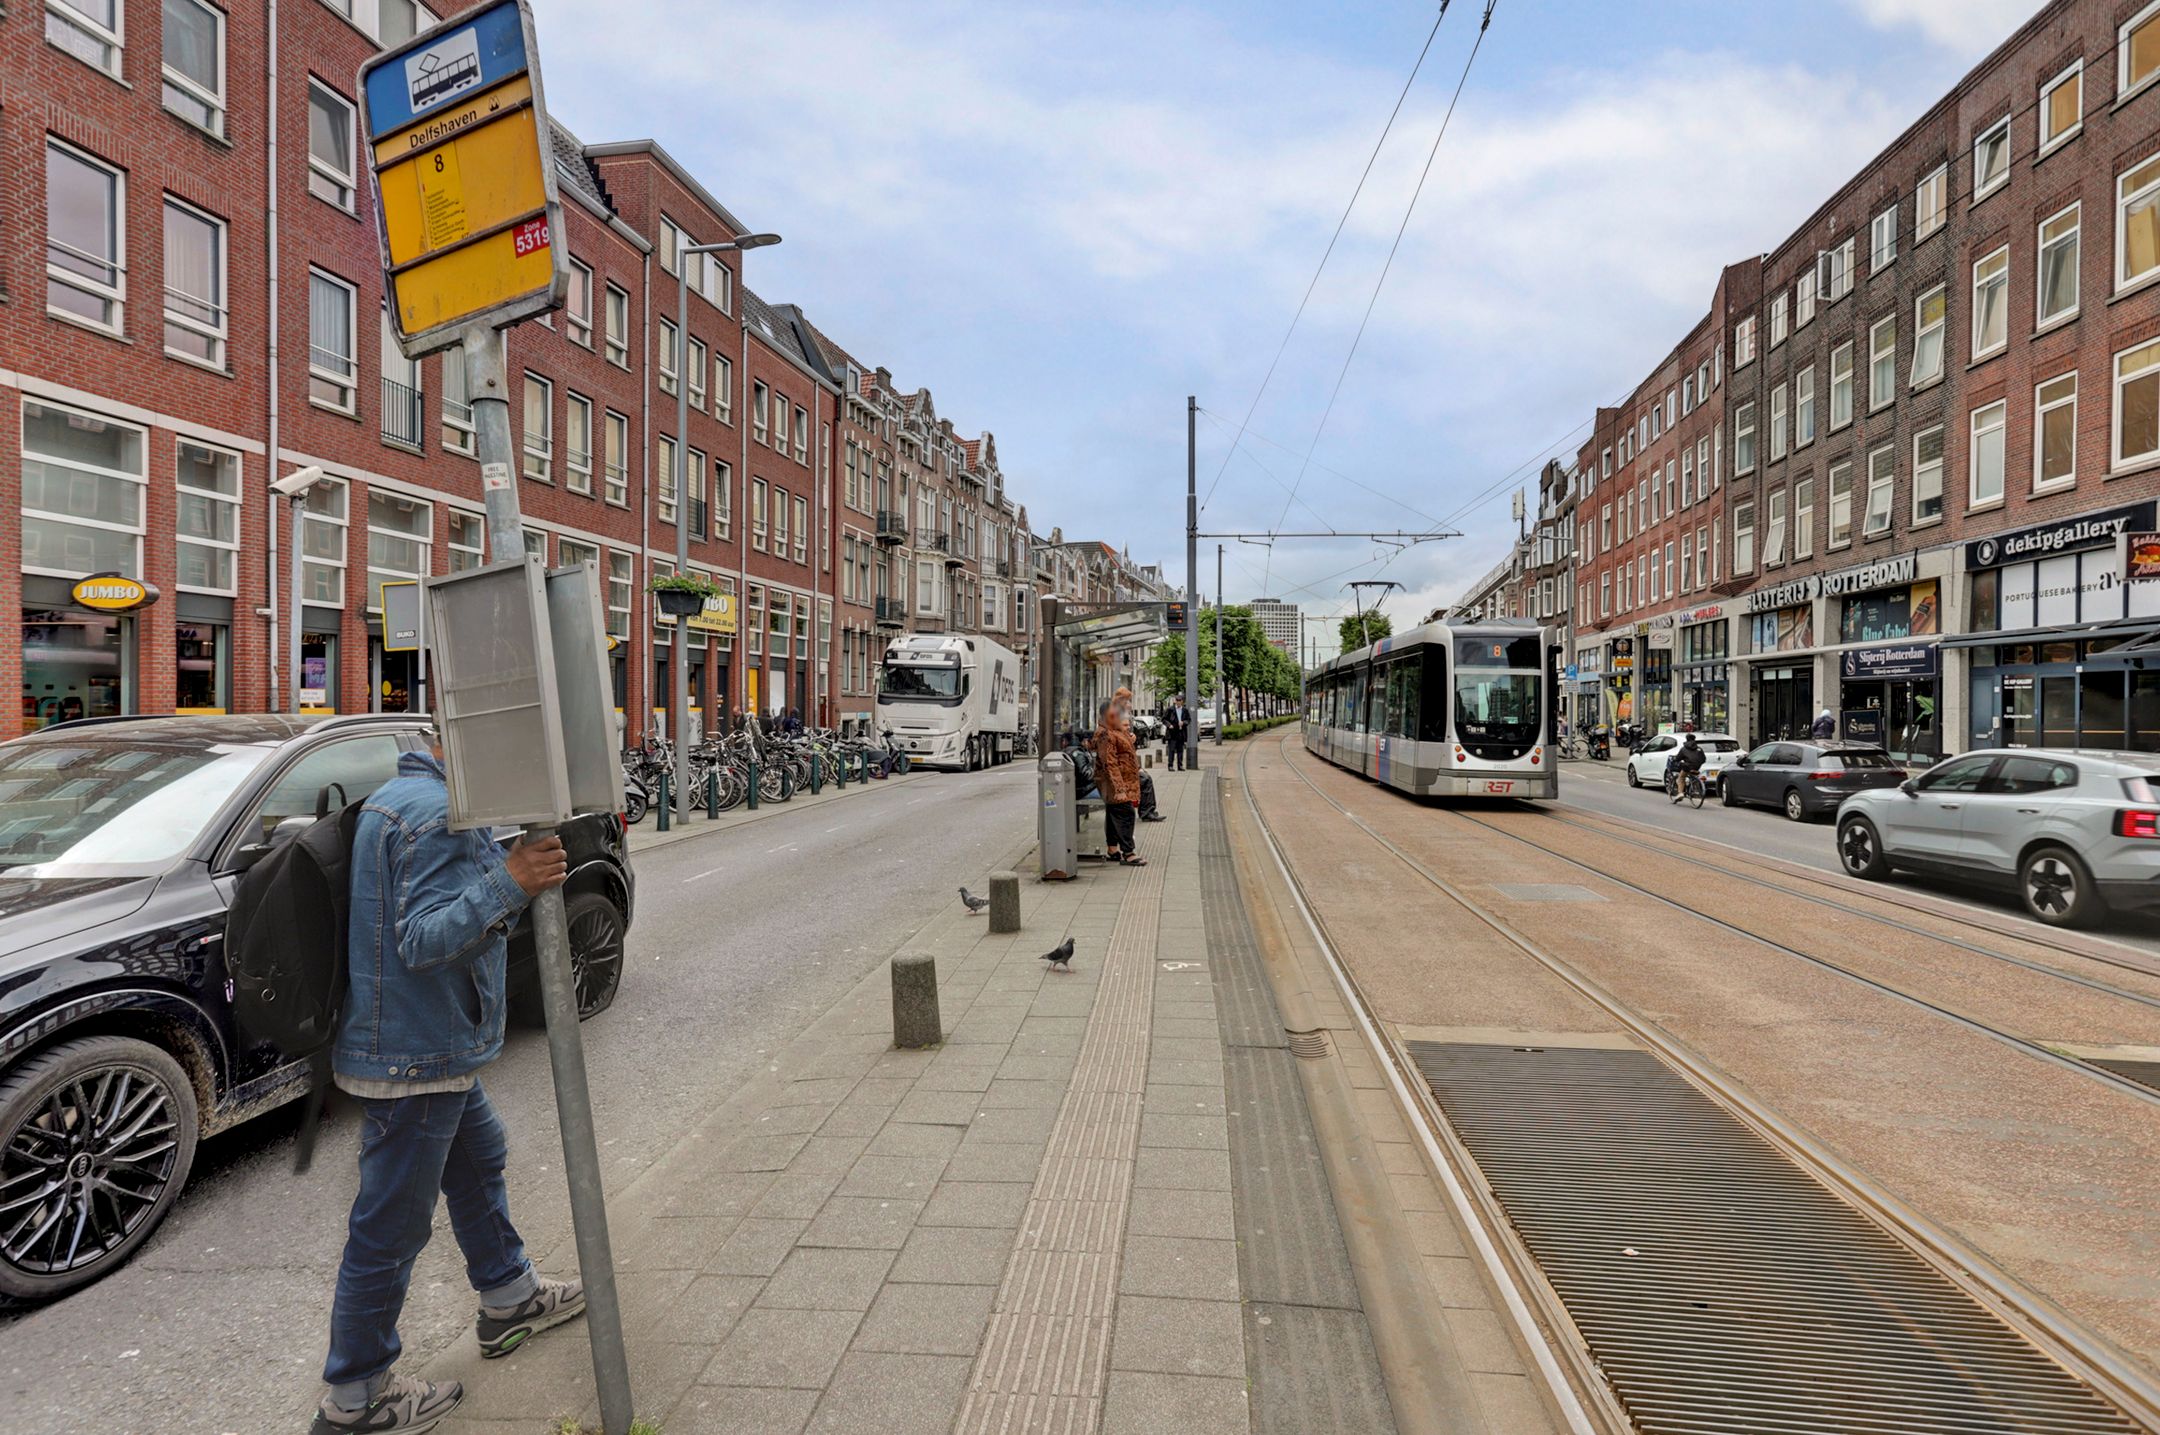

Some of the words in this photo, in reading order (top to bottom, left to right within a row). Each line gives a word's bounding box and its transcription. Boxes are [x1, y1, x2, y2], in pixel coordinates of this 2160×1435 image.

[409, 110, 478, 149] Delfshaven
[433, 153, 445, 173] 8
[524, 221, 540, 233] Zone
[516, 226, 550, 253] 5319
[2005, 515, 2127, 556] dekipgallery
[79, 585, 140, 600] JUMBO
[1746, 581, 1806, 611] SLIJTERIJ
[1822, 556, 1915, 595] ROTTERDAM
[1862, 625, 1884, 641] Blue
[1493, 645, 1501, 657] 8
[1859, 650, 1885, 666] Slijterij
[1885, 646, 1926, 661] Rotterdam
[1487, 781, 1515, 793] RET
